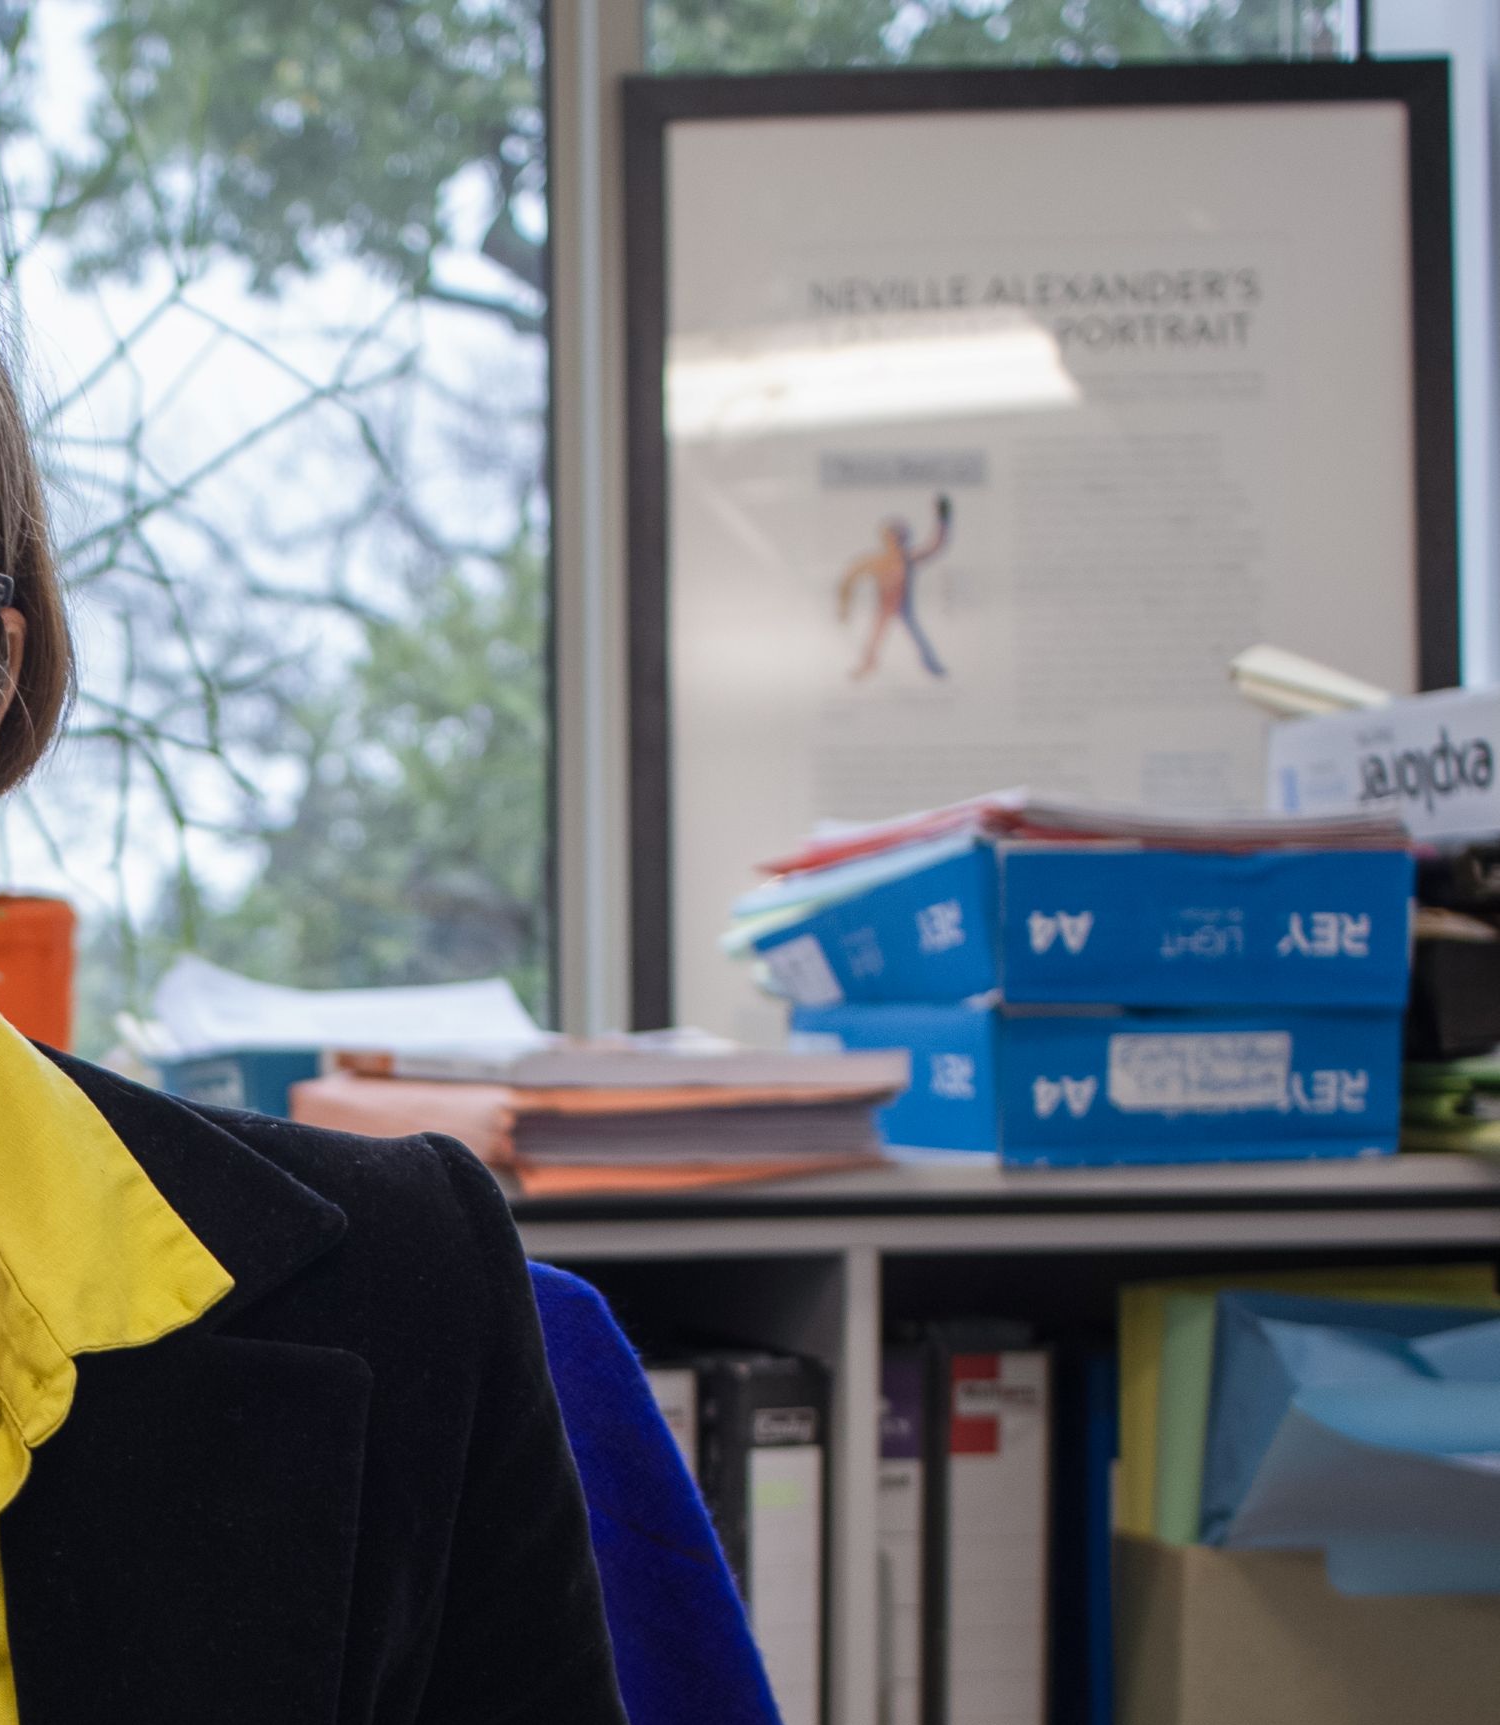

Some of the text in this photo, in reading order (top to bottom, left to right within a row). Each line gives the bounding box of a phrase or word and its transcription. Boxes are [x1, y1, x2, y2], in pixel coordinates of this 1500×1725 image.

[808, 267, 1262, 310] NEVILLE ALEXANDER'S
[1055, 310, 1252, 350] PORTRAIT
[1025, 909, 1095, 954] A4
[1275, 911, 1371, 958] REY
[1031, 1074, 1098, 1118] A4
